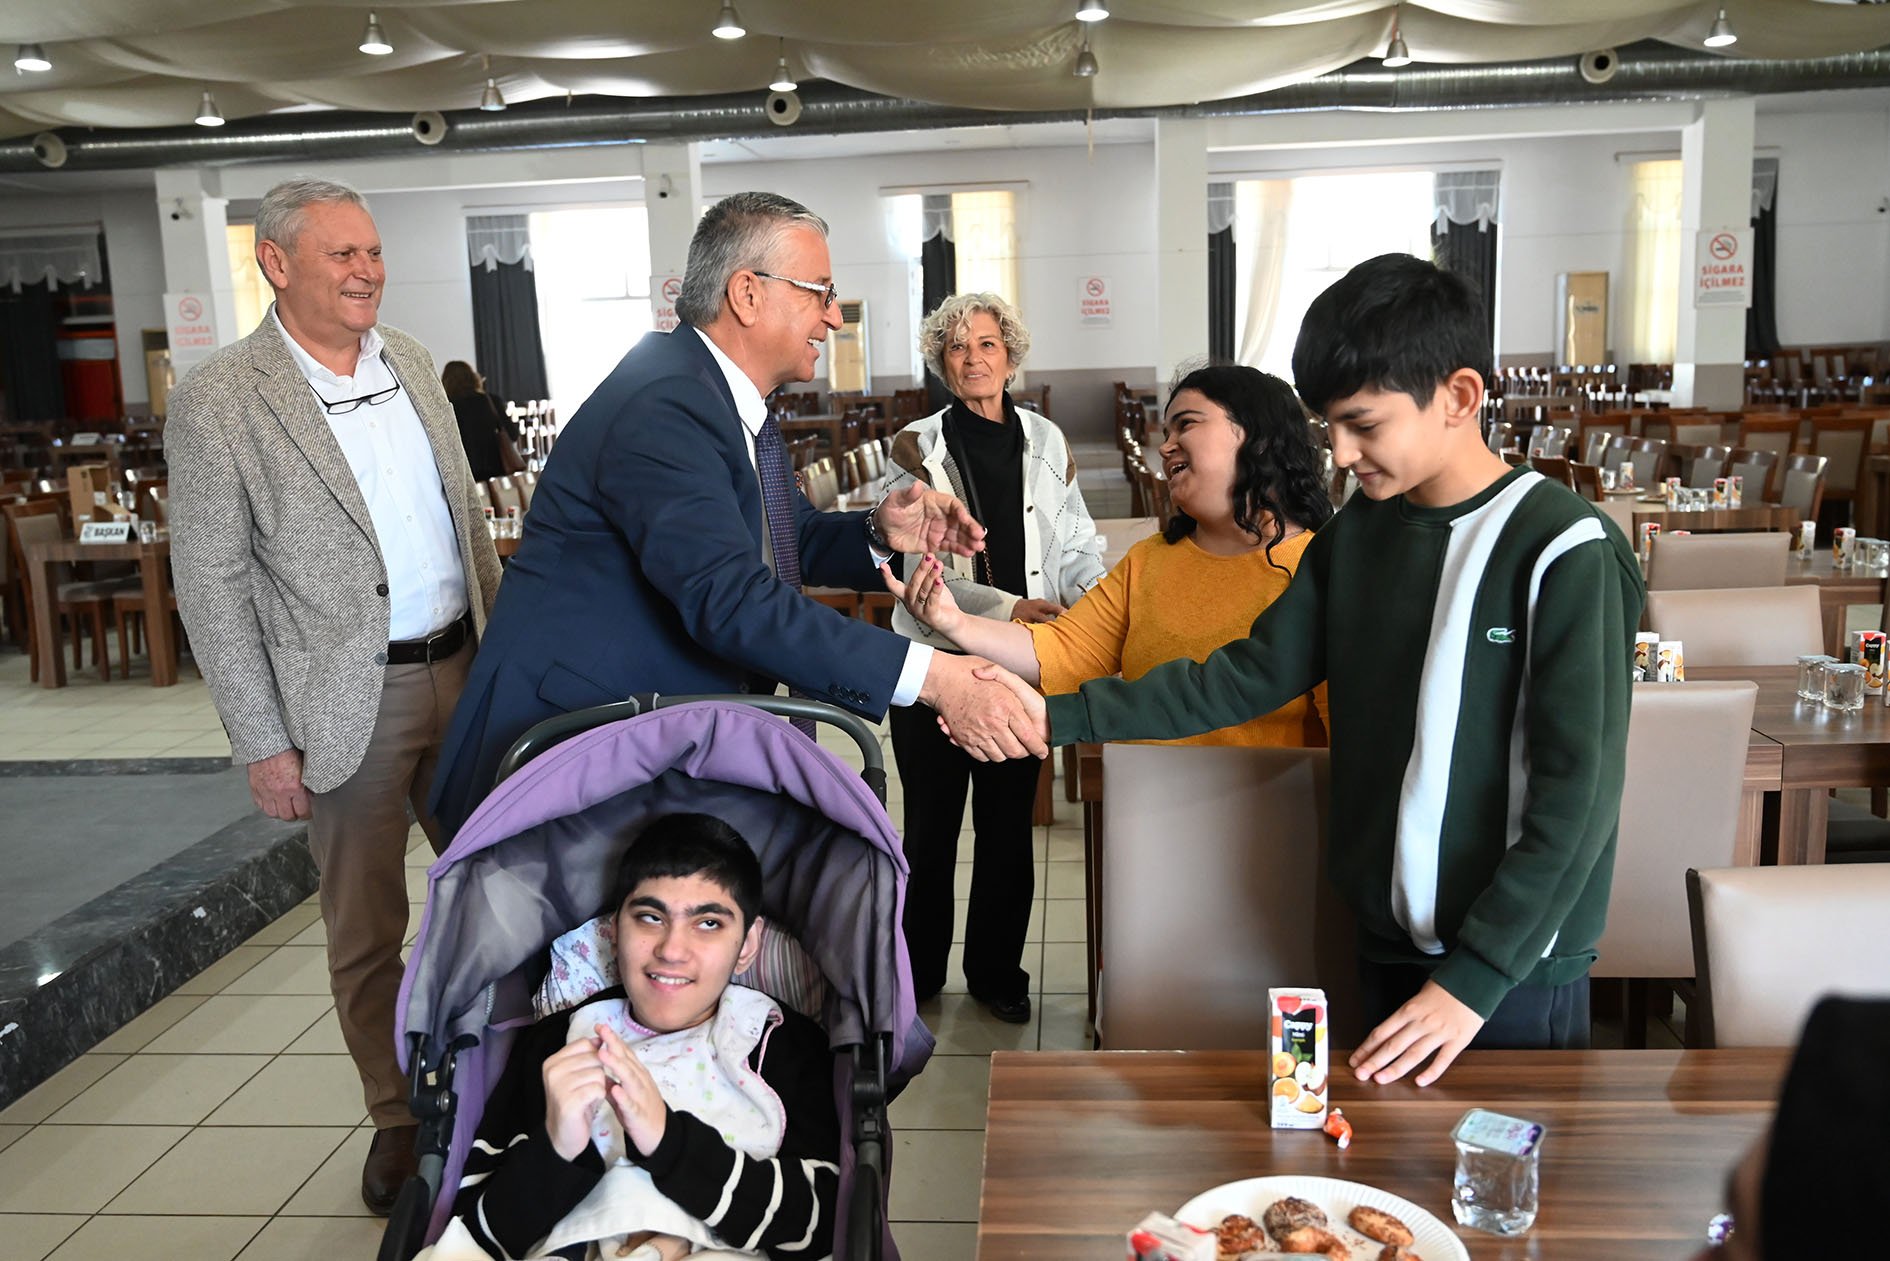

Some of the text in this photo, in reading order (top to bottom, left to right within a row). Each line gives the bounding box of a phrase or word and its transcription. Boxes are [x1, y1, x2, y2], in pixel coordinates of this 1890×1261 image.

[1701, 264, 1744, 275] SİGARA
[1700, 277, 1745, 289] İÇİLMEZ
[656, 308, 673, 317] SİG
[95, 527, 125, 537] BAŞKAN
